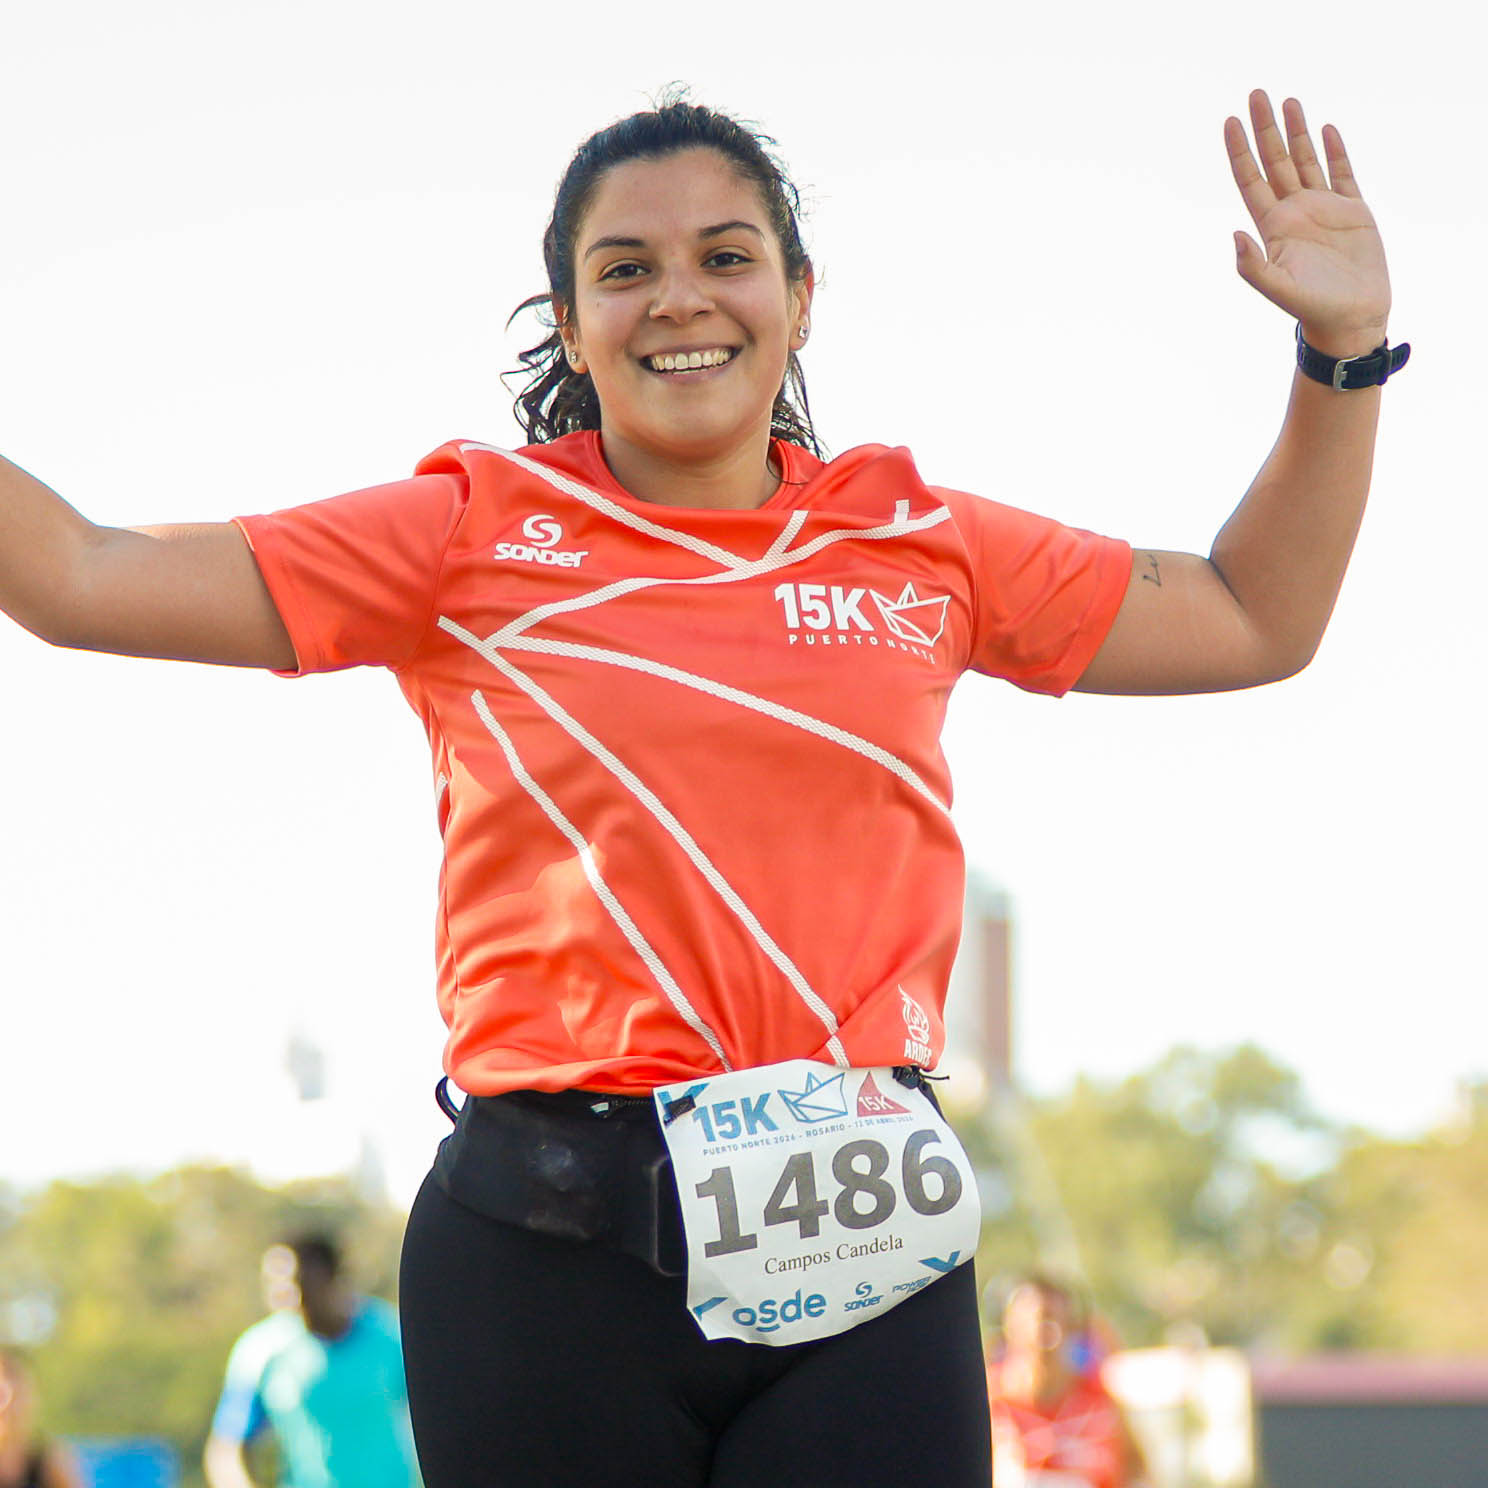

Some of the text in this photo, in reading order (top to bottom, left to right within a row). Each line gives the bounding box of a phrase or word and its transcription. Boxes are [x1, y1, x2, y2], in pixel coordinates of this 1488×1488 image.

[774, 583, 875, 631] 15K
[788, 634, 879, 645] PUERTO
[693, 1092, 779, 1142] 15K
[858, 1095, 895, 1111] 15K
[703, 1143, 739, 1156] PUERTO
[740, 1138, 771, 1150] NORTE
[805, 1123, 846, 1138] ROSARIO
[695, 1129, 963, 1258] 1486
[764, 1234, 904, 1274] Campos Candela
[732, 1288, 827, 1328] osde
